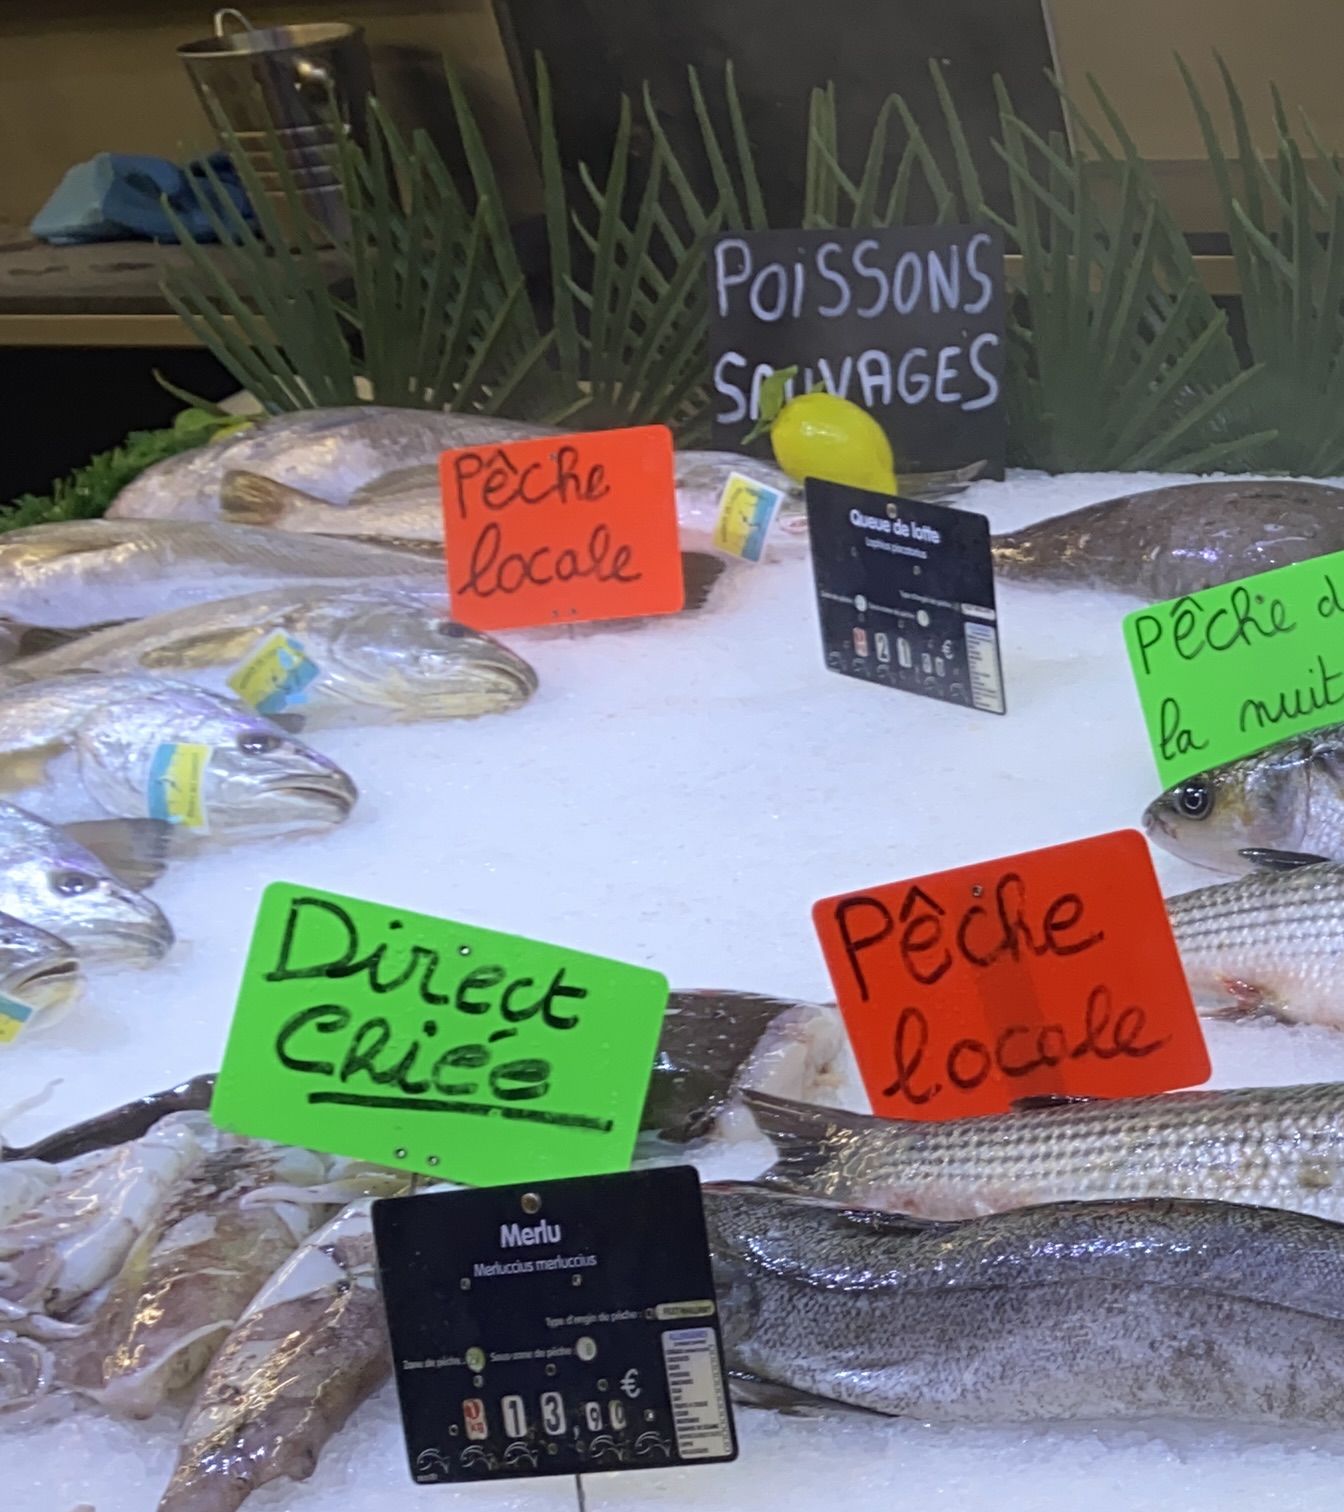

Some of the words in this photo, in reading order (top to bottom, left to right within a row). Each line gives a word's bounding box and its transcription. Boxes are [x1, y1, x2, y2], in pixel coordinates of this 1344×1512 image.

[453, 446, 611, 519] Pêche
[457, 522, 643, 598] locale
[1135, 586, 1297, 675] Pêche
[1159, 697, 1210, 760] la
[263, 896, 589, 1031] Direct
[834, 872, 1105, 1003] Pêche
[882, 983, 1174, 1105] locale
[473, 1258, 534, 1278] Merluccius
[535, 1252, 597, 1272] merluccius
[500, 1219, 562, 1249] Merlu
[620, 1368, 643, 1399] €
